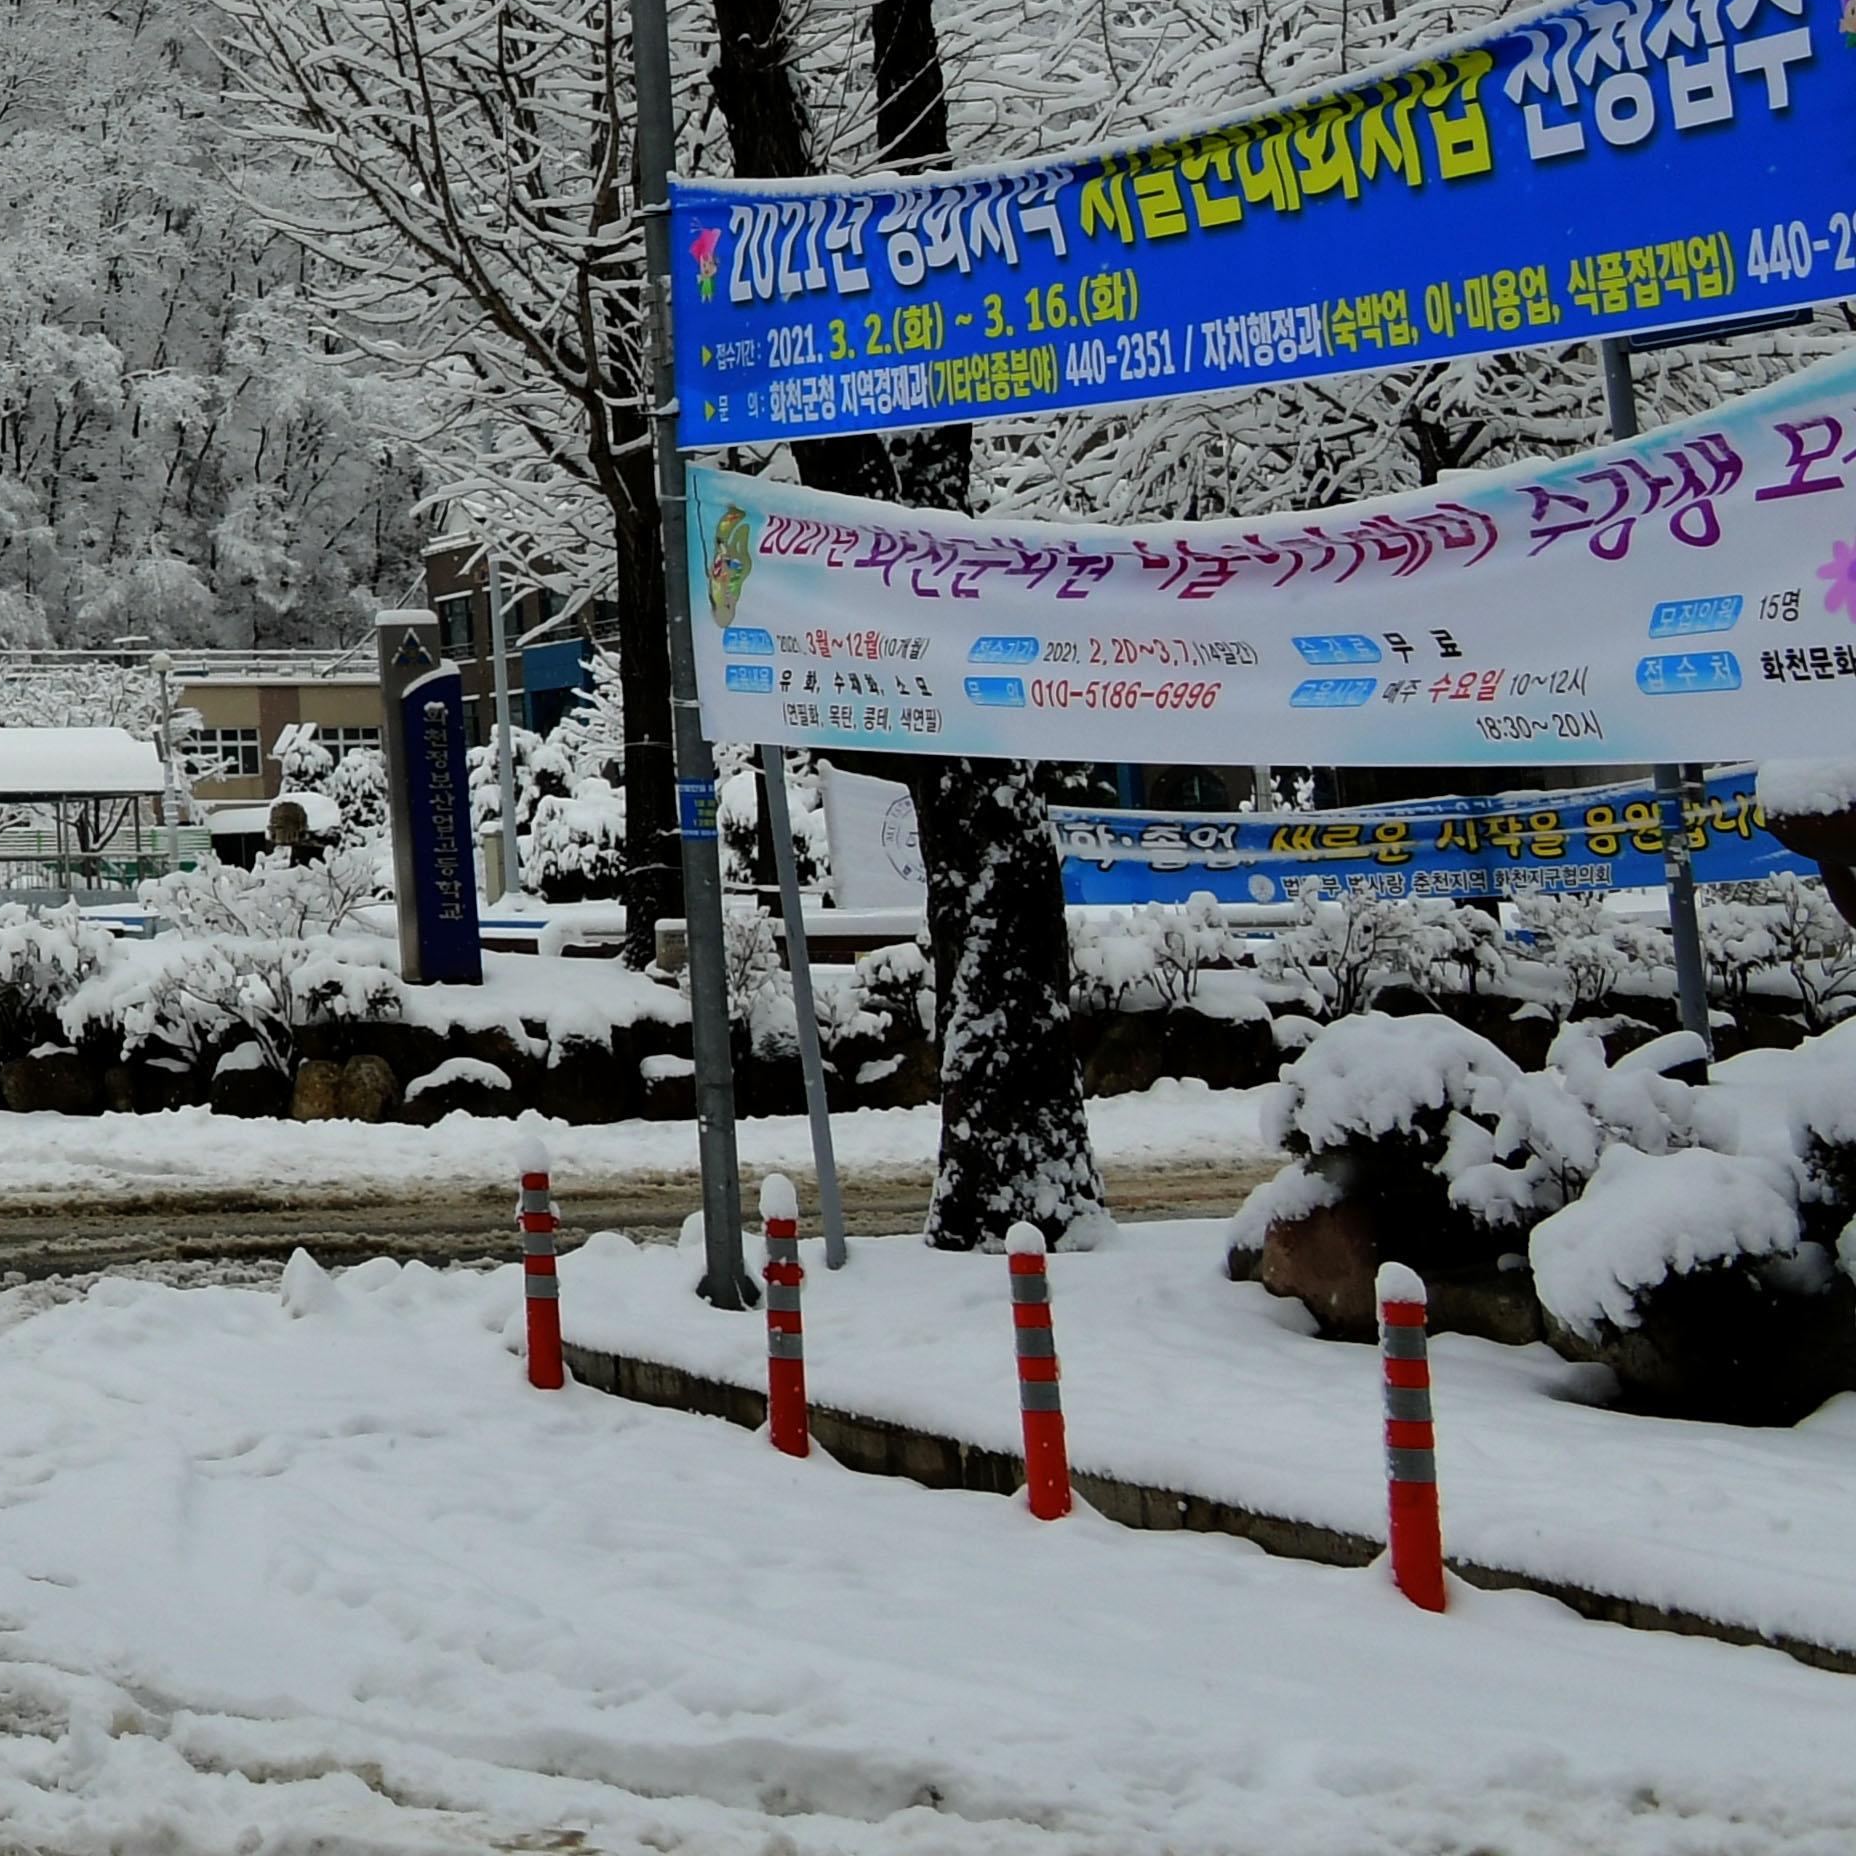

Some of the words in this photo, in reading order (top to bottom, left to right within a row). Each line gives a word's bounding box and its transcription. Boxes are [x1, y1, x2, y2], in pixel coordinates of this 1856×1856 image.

[729, 196, 870, 302] 2021년
[769, 374, 837, 424] 화천군청
[1065, 325, 1177, 388] 440-2351
[1565, 230, 1736, 304] 식품접객업)
[1746, 209, 1856, 284] 440-2
[767, 324, 823, 367] 2021.
[758, 514, 860, 568] 2021년
[1516, 432, 1745, 560] 수강생
[1754, 416, 1856, 502] 모
[1759, 587, 1802, 623] 15명
[1043, 641, 1082, 664] 2021.
[1031, 678, 1222, 710] 010-5186-6996
[1427, 668, 1505, 703] 수요일
[1509, 665, 1589, 697] 10~12시
[422, 701, 464, 921] 화천정보산업고등학교
[1269, 819, 1413, 864] 새로운
[1436, 809, 1567, 858] 시작을
[1281, 873, 1341, 899] 법부
[1412, 868, 1488, 894] 춘천지역
[1494, 862, 1613, 890] 화천지구협의회
